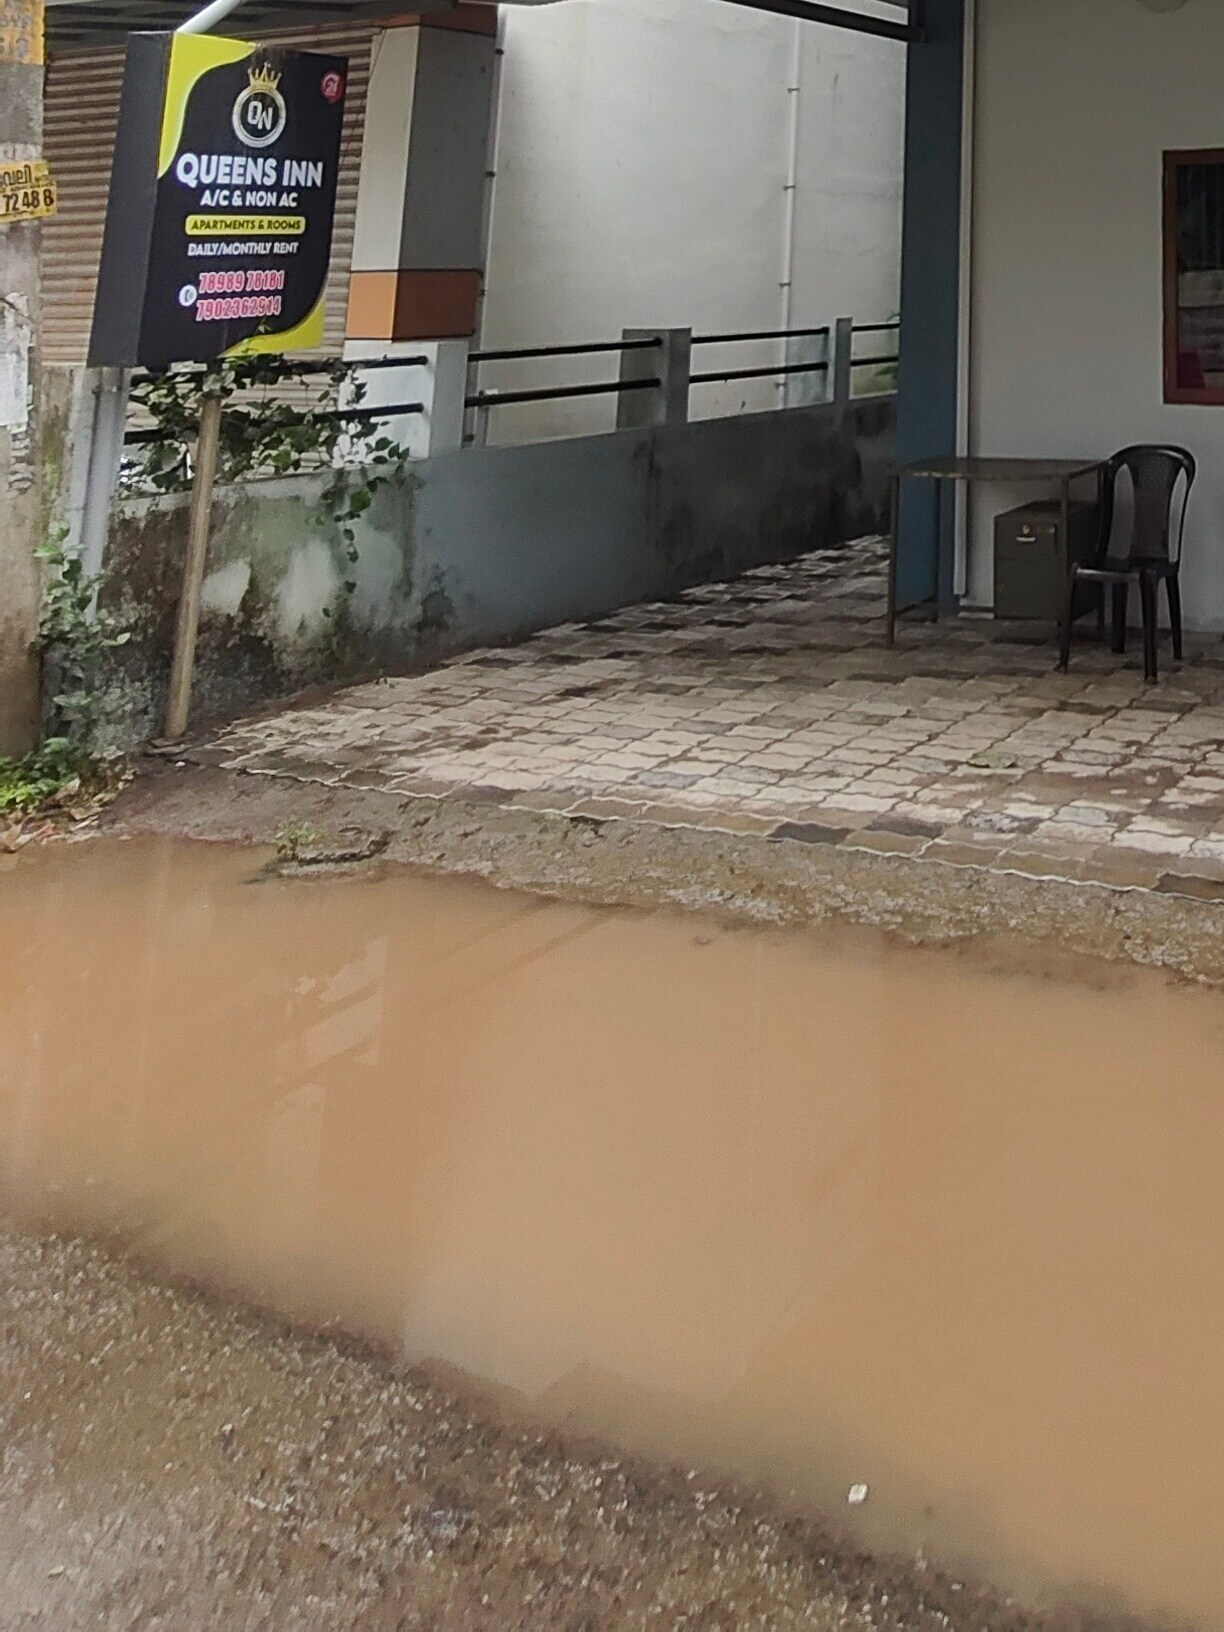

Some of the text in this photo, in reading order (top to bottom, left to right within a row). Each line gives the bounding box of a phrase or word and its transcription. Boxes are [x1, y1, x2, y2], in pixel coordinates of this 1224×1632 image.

[176, 153, 323, 188] QUEENS INN
[200, 189, 299, 207] A/C & NON AC
[191, 219, 256, 230] APARTMENTS
[267, 220, 301, 230] ROOMS
[187, 242, 298, 256] DAILY/MONTHLY RENT
